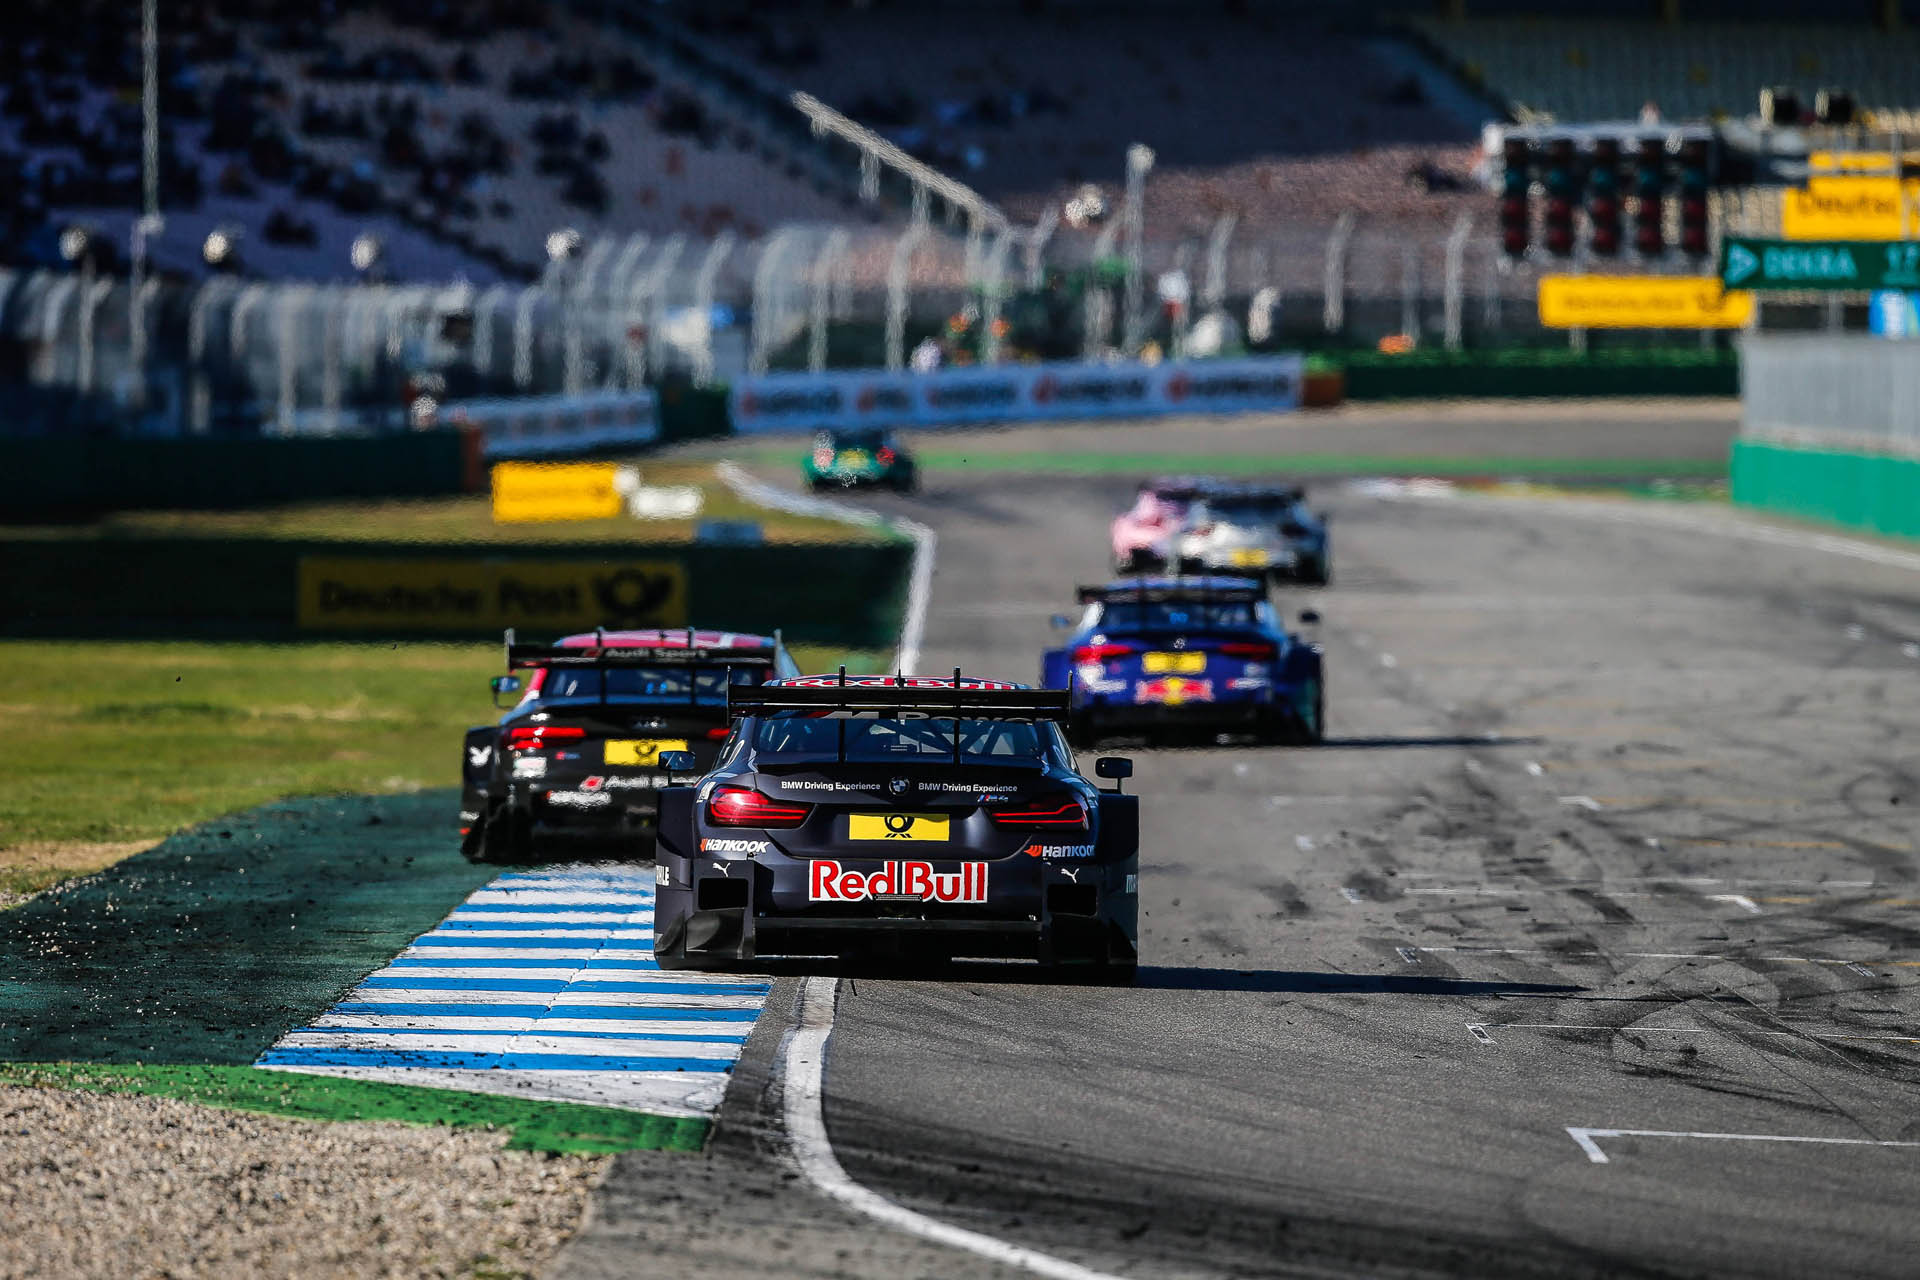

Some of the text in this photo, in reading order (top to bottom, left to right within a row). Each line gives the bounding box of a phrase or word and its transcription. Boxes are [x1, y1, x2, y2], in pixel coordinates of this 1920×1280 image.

[499, 578, 580, 614] Post
[781, 781, 881, 791] BMW Driving Experience
[918, 782, 1018, 793] BMW Driving Experience
[809, 859, 989, 904] Red Bull
